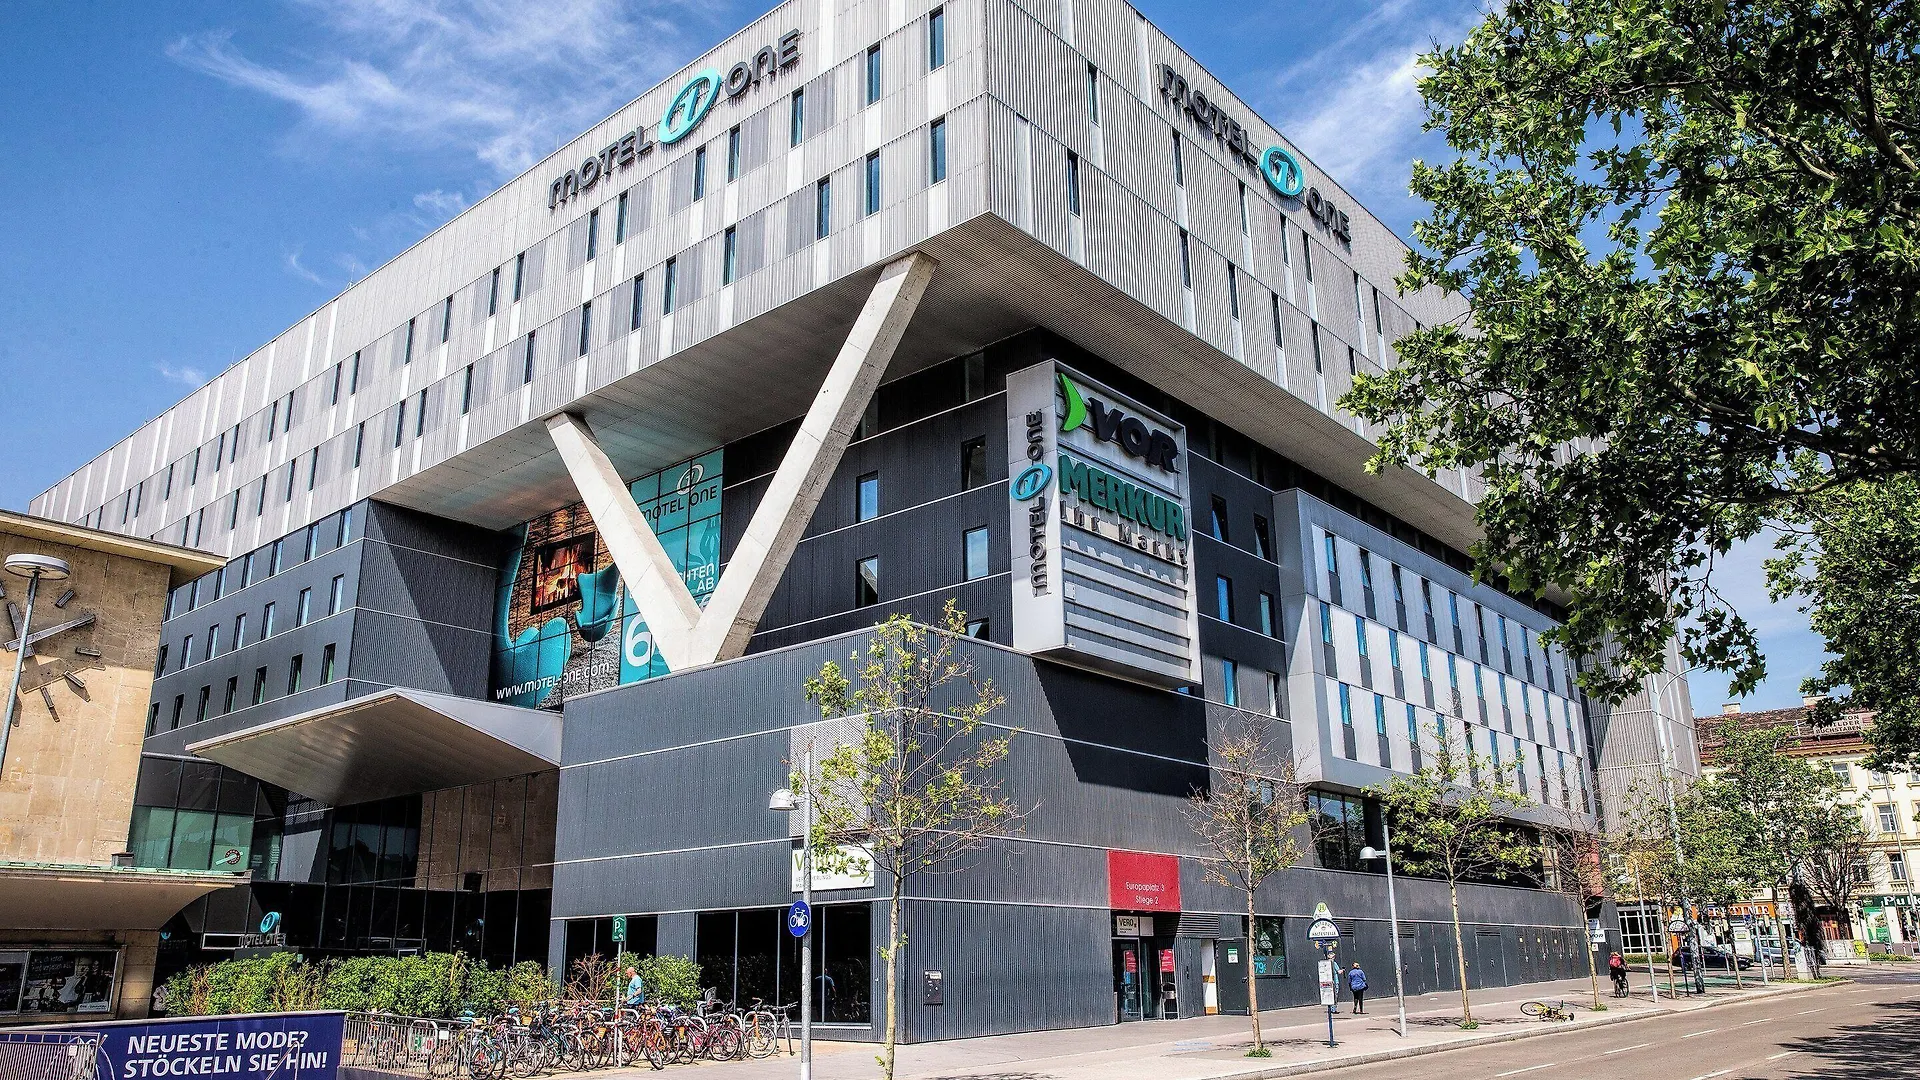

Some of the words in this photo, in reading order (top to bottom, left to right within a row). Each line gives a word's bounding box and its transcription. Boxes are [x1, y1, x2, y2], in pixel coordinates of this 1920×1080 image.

[548, 125, 653, 209] MOTEL
[725, 28, 800, 97] ONE
[1156, 63, 1258, 166] MOTEL
[1306, 187, 1351, 243] ONE
[1026, 409, 1044, 461] ONE
[1088, 397, 1179, 473] VOR
[689, 485, 718, 506] ONE
[1058, 454, 1186, 541] MERKUR
[1029, 496, 1047, 598] MOTEL
[1060, 500, 1101, 533] Ihr
[1118, 523, 1188, 565] Markt
[697, 577, 714, 594] AB
[1125, 881, 1160, 891] Europaplatz
[1161, 883, 1165, 892] 3
[1136, 895, 1153, 905] Stiege
[1154, 896, 1159, 904] 2
[124, 1054, 242, 1079] STÖCKELN
[248, 1053, 278, 1072] SIE
[285, 1051, 328, 1070] HIN!
[127, 1033, 229, 1055] NEUESTE
[235, 1030, 309, 1050] MODE?
